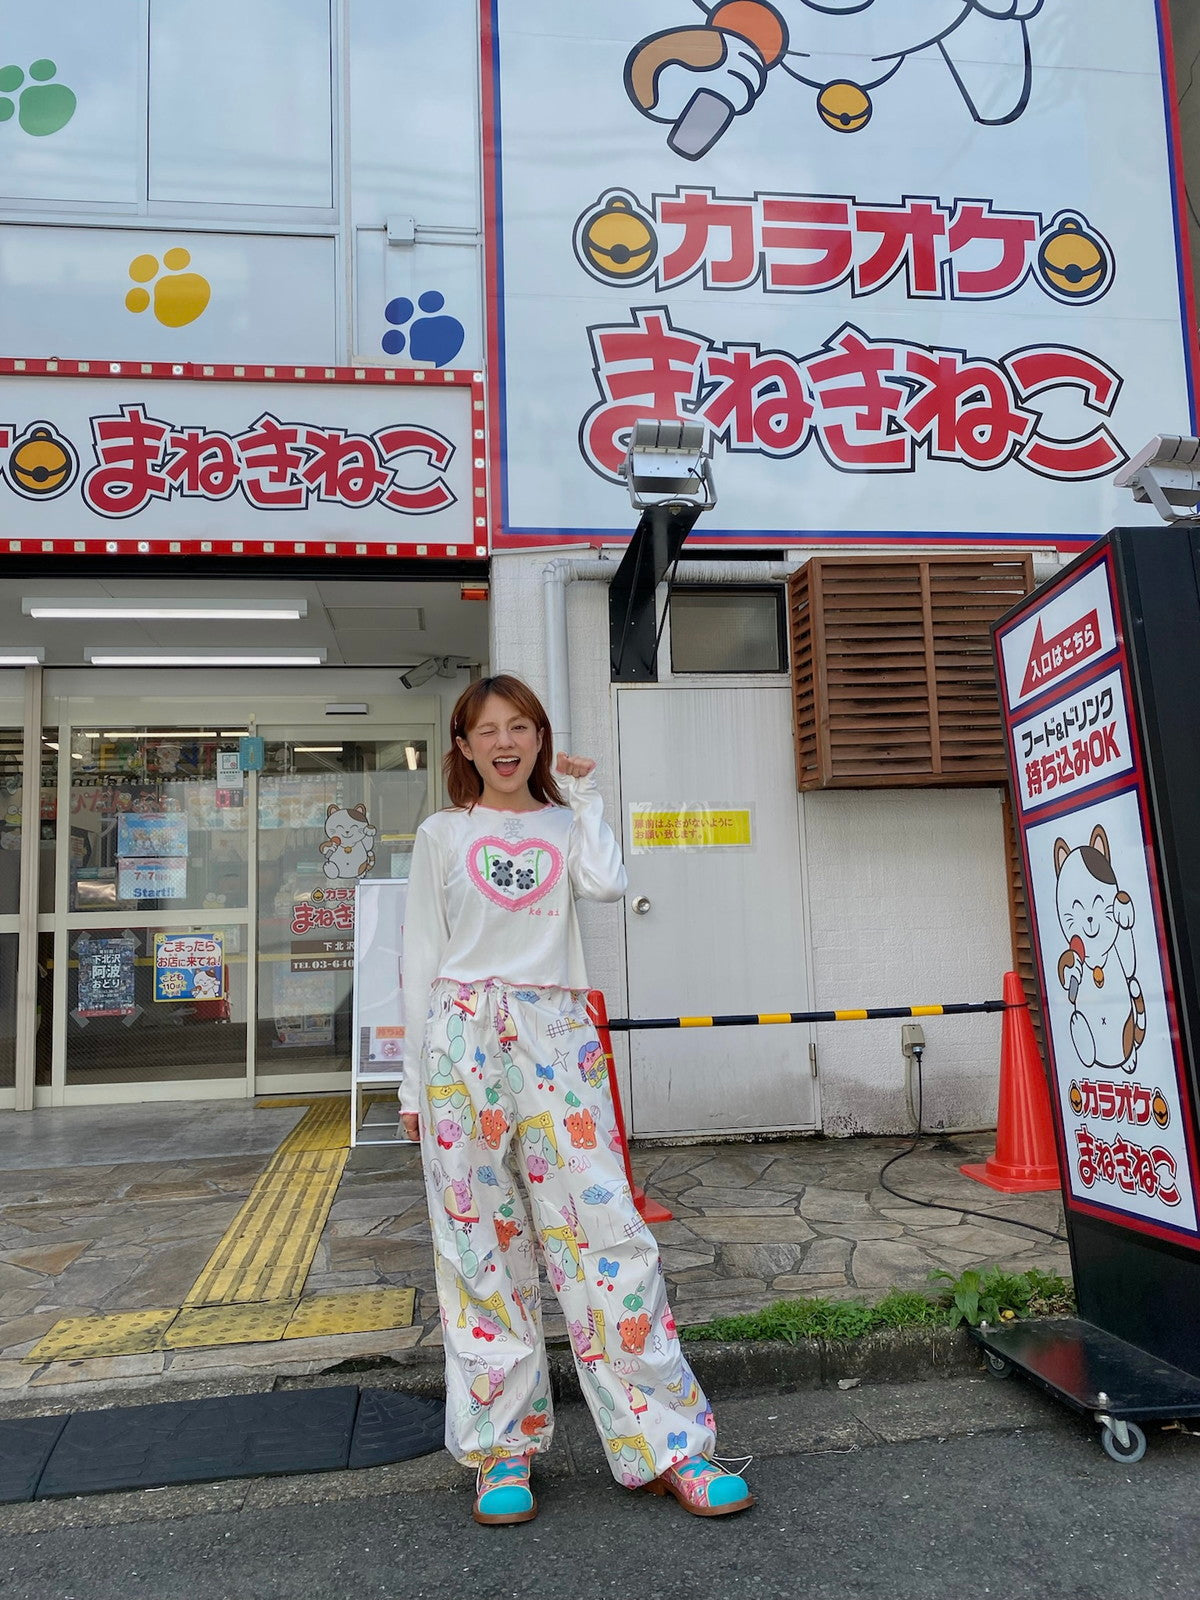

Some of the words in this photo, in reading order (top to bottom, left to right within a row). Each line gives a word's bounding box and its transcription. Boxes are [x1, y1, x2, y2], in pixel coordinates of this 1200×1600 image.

[655, 188, 1041, 299] カラオケ
[579, 306, 1127, 479] まねきねこ
[83, 403, 456, 518] まねきねこ
[1031, 623, 1095, 683] 入口はこちら
[1021, 687, 1114, 758] フード&ドリンク
[1025, 721, 1121, 798] 持ち込みOK
[133, 887, 175, 898] Start!!
[291, 902, 355, 934] まねき
[92, 954, 121, 964] 下北沢
[157, 956, 221, 967] お店に来てね!
[164, 941, 215, 952] こまったら
[92, 965, 120, 979] 阿波
[92, 979, 120, 988] おどり
[1080, 1079, 1152, 1124] カラオケ
[1076, 1125, 1181, 1206] まねきねこ
